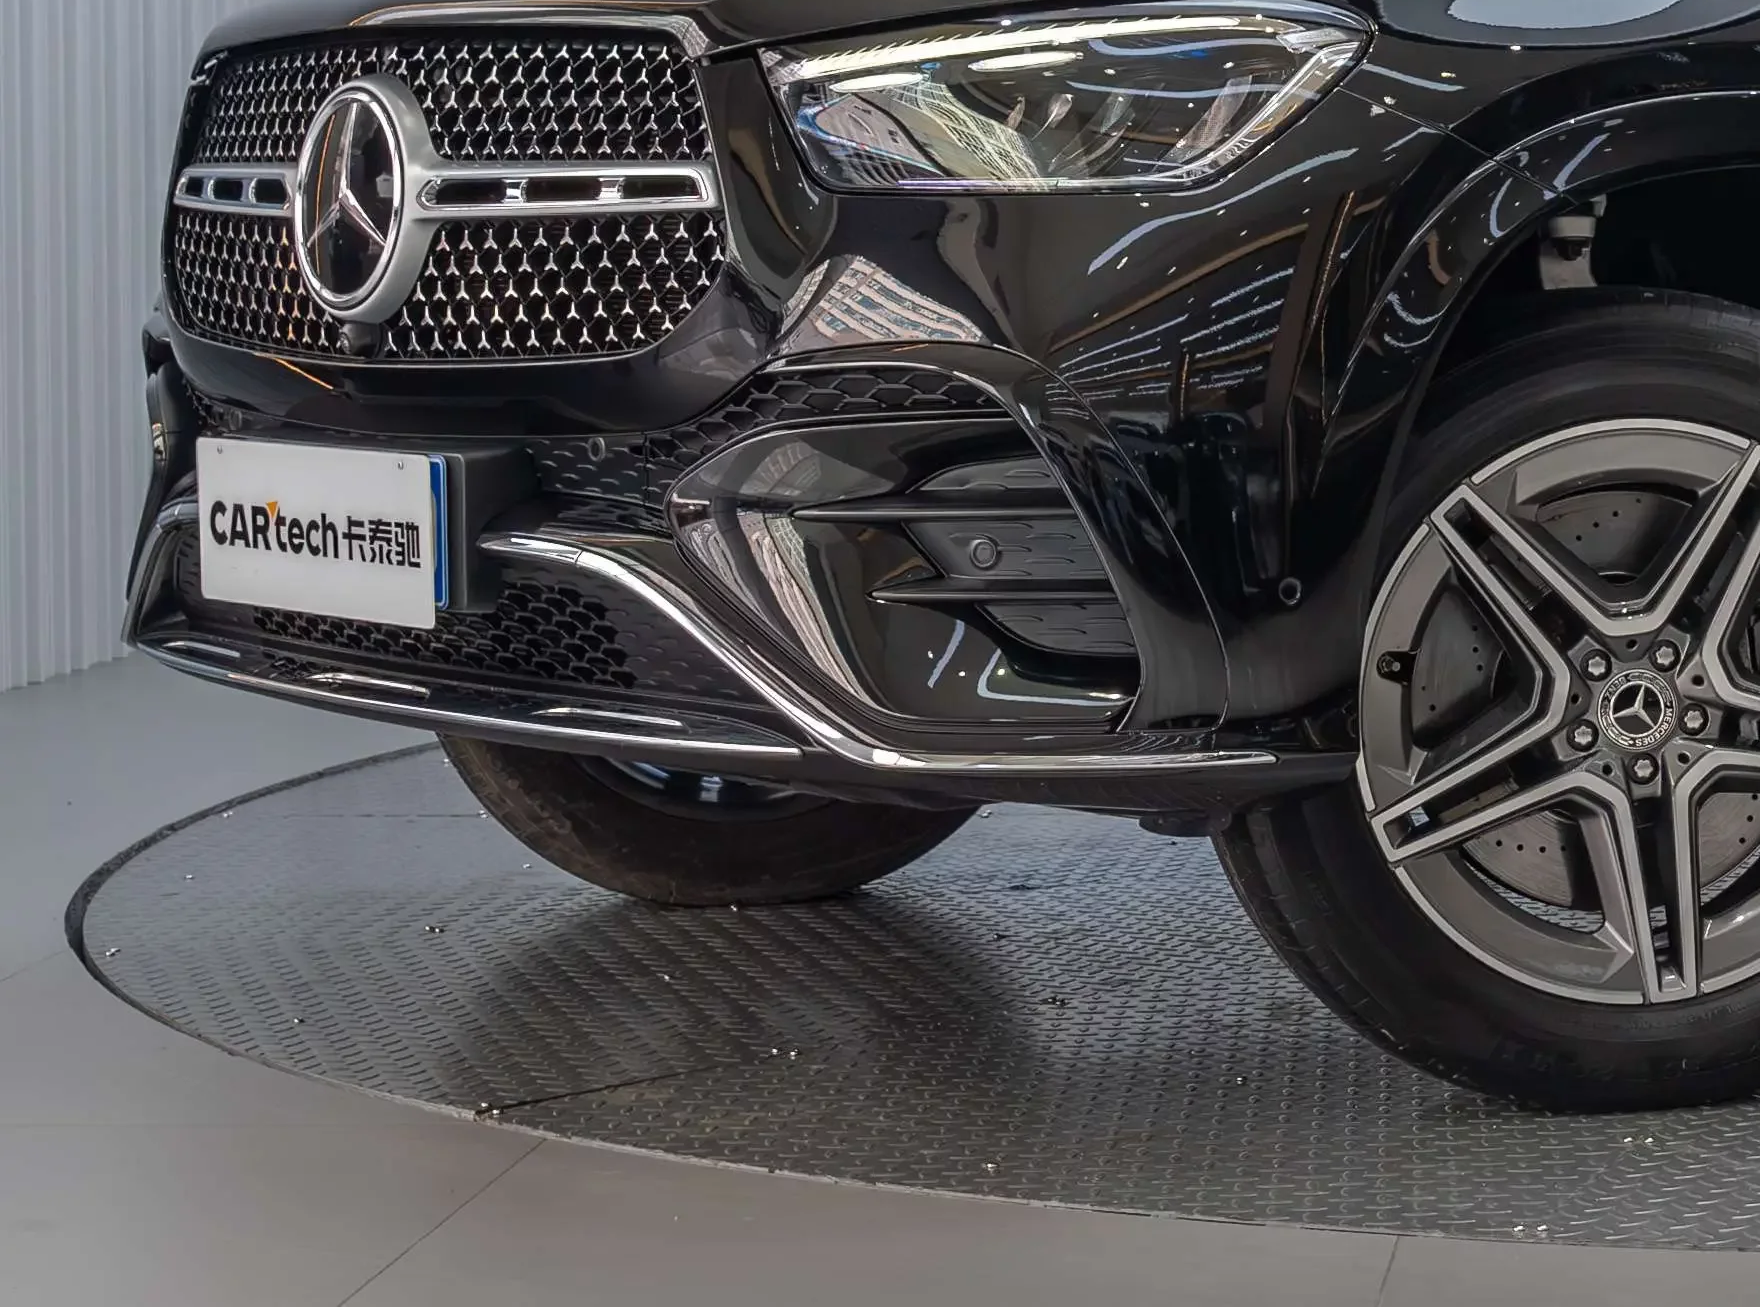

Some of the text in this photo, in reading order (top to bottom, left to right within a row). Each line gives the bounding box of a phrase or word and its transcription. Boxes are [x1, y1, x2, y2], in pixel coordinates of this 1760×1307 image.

[210, 500, 421, 569] CARtech 卡泰驰
[1635, 708, 1673, 747] MERCEDES
